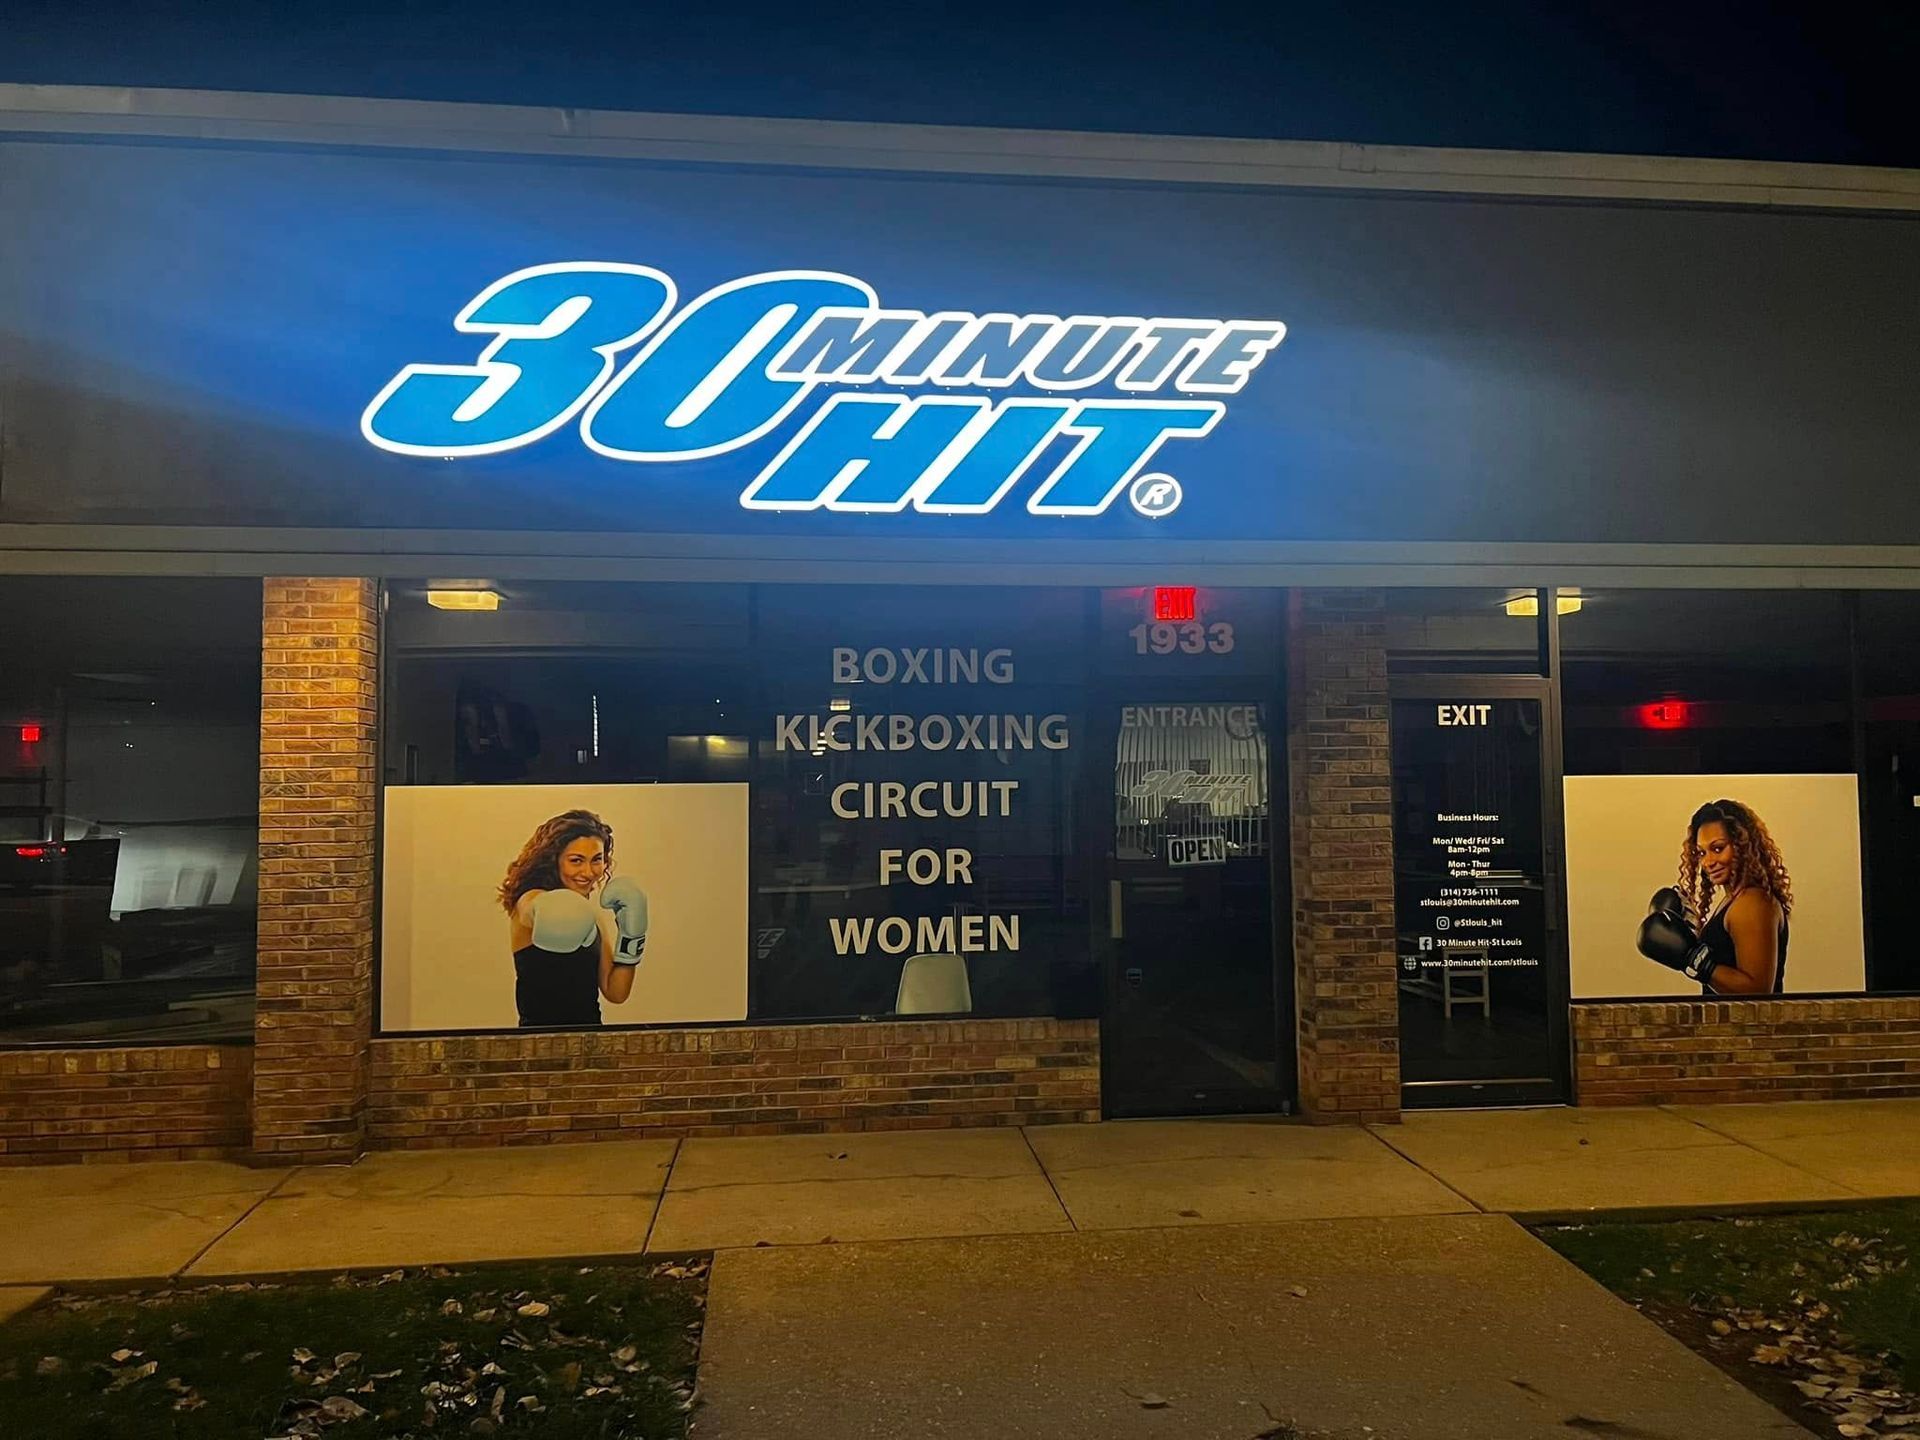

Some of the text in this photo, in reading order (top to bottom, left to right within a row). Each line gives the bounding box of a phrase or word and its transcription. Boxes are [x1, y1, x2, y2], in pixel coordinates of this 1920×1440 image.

[360, 261, 1288, 463] 30 MINUTE
[739, 394, 1227, 516] HIT
[1155, 586, 1196, 620] EXIT
[1129, 622, 1235, 655] 1933
[832, 648, 1015, 684] BOXING
[1121, 706, 1259, 727] ENTRANCE
[1437, 704, 1491, 727] EXIT
[775, 714, 1070, 751] KICKBOXING
[1183, 774, 1252, 785] MINUTE
[830, 780, 1019, 819] CIRCUIT
[1437, 813, 1500, 822] Business Hours:
[1171, 839, 1224, 863] OPEN
[1432, 837, 1505, 846] Mon/ Wed/ Fri/ Sat
[1447, 846, 1491, 855] 8am-12pm
[879, 847, 974, 886] FOR
[1447, 860, 1467, 868] Mon
[1471, 860, 1491, 868] Thur
[1450, 869, 1489, 878] 4pm-8pm
[1420, 898, 1520, 907] stlouis@30minutehit.com
[1440, 888, 1499, 897] (314) 736-1111
[829, 914, 1020, 955] WOMEN
[1436, 939, 1447, 947] 30
[1448, 939, 1477, 947] Minute
[1501, 938, 1522, 947] Louis
[1420, 958, 1538, 968] www.30minutehit.com/stlouis
